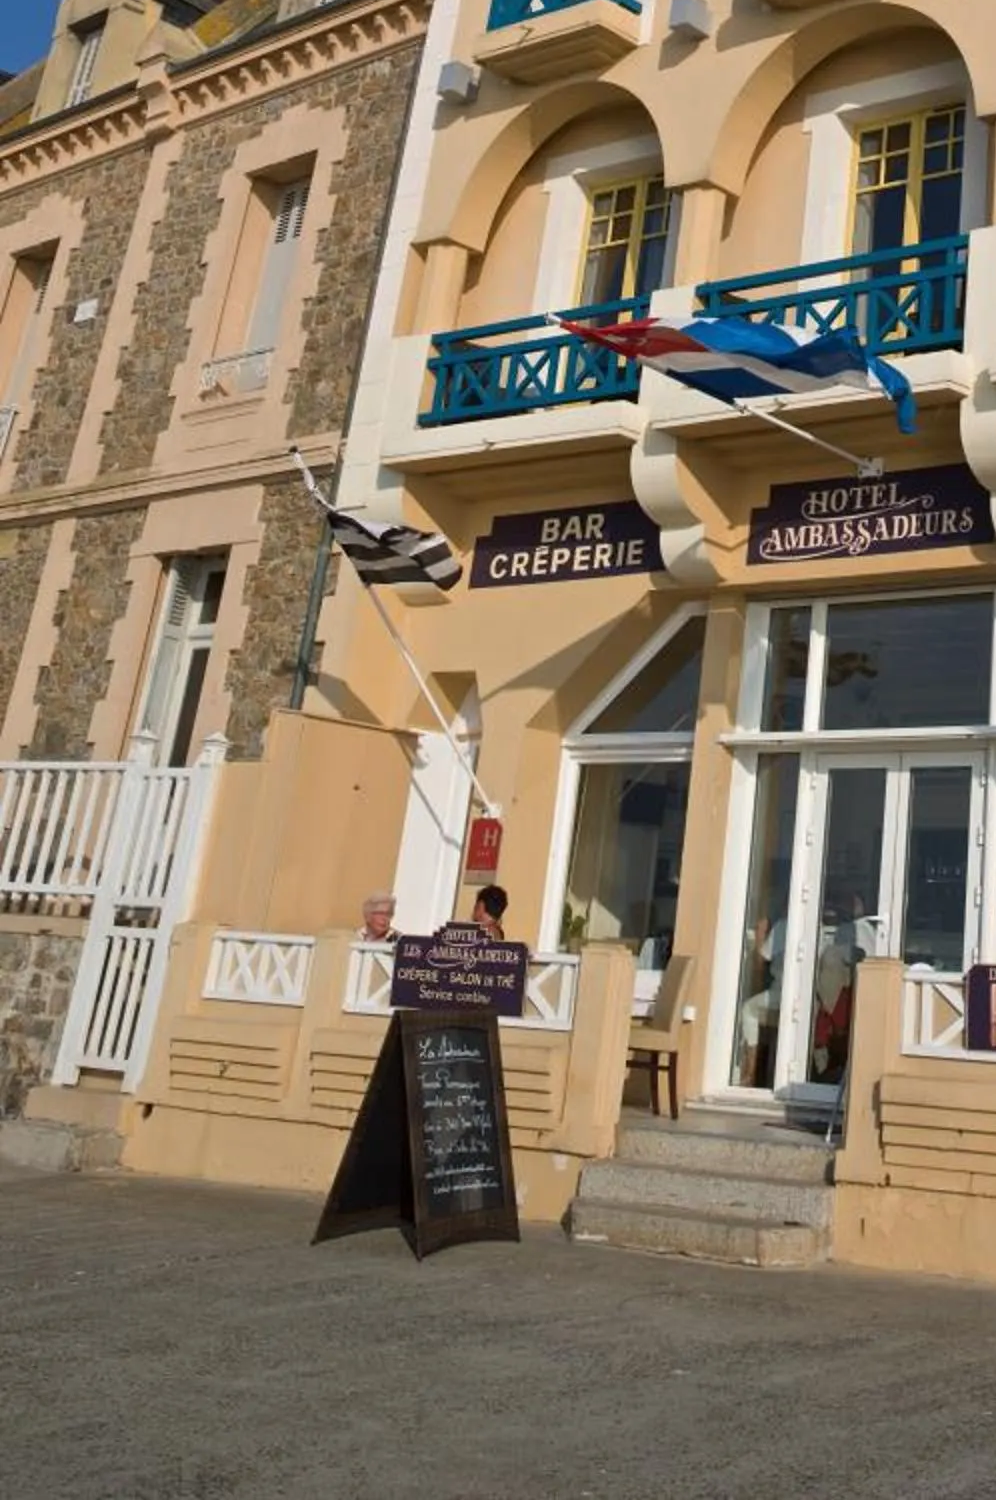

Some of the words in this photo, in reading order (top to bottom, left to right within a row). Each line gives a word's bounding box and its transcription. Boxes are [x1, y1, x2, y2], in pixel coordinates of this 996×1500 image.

[804, 483, 912, 518] HOTEL
[541, 513, 605, 543] BAR
[761, 507, 974, 556] AMBASSADEURS
[489, 544, 645, 579] CRÊPERIE
[483, 827, 499, 848] H
[442, 928, 478, 943] HOTEL
[449, 970, 481, 986] SALON
[419, 984, 453, 1001] Service
